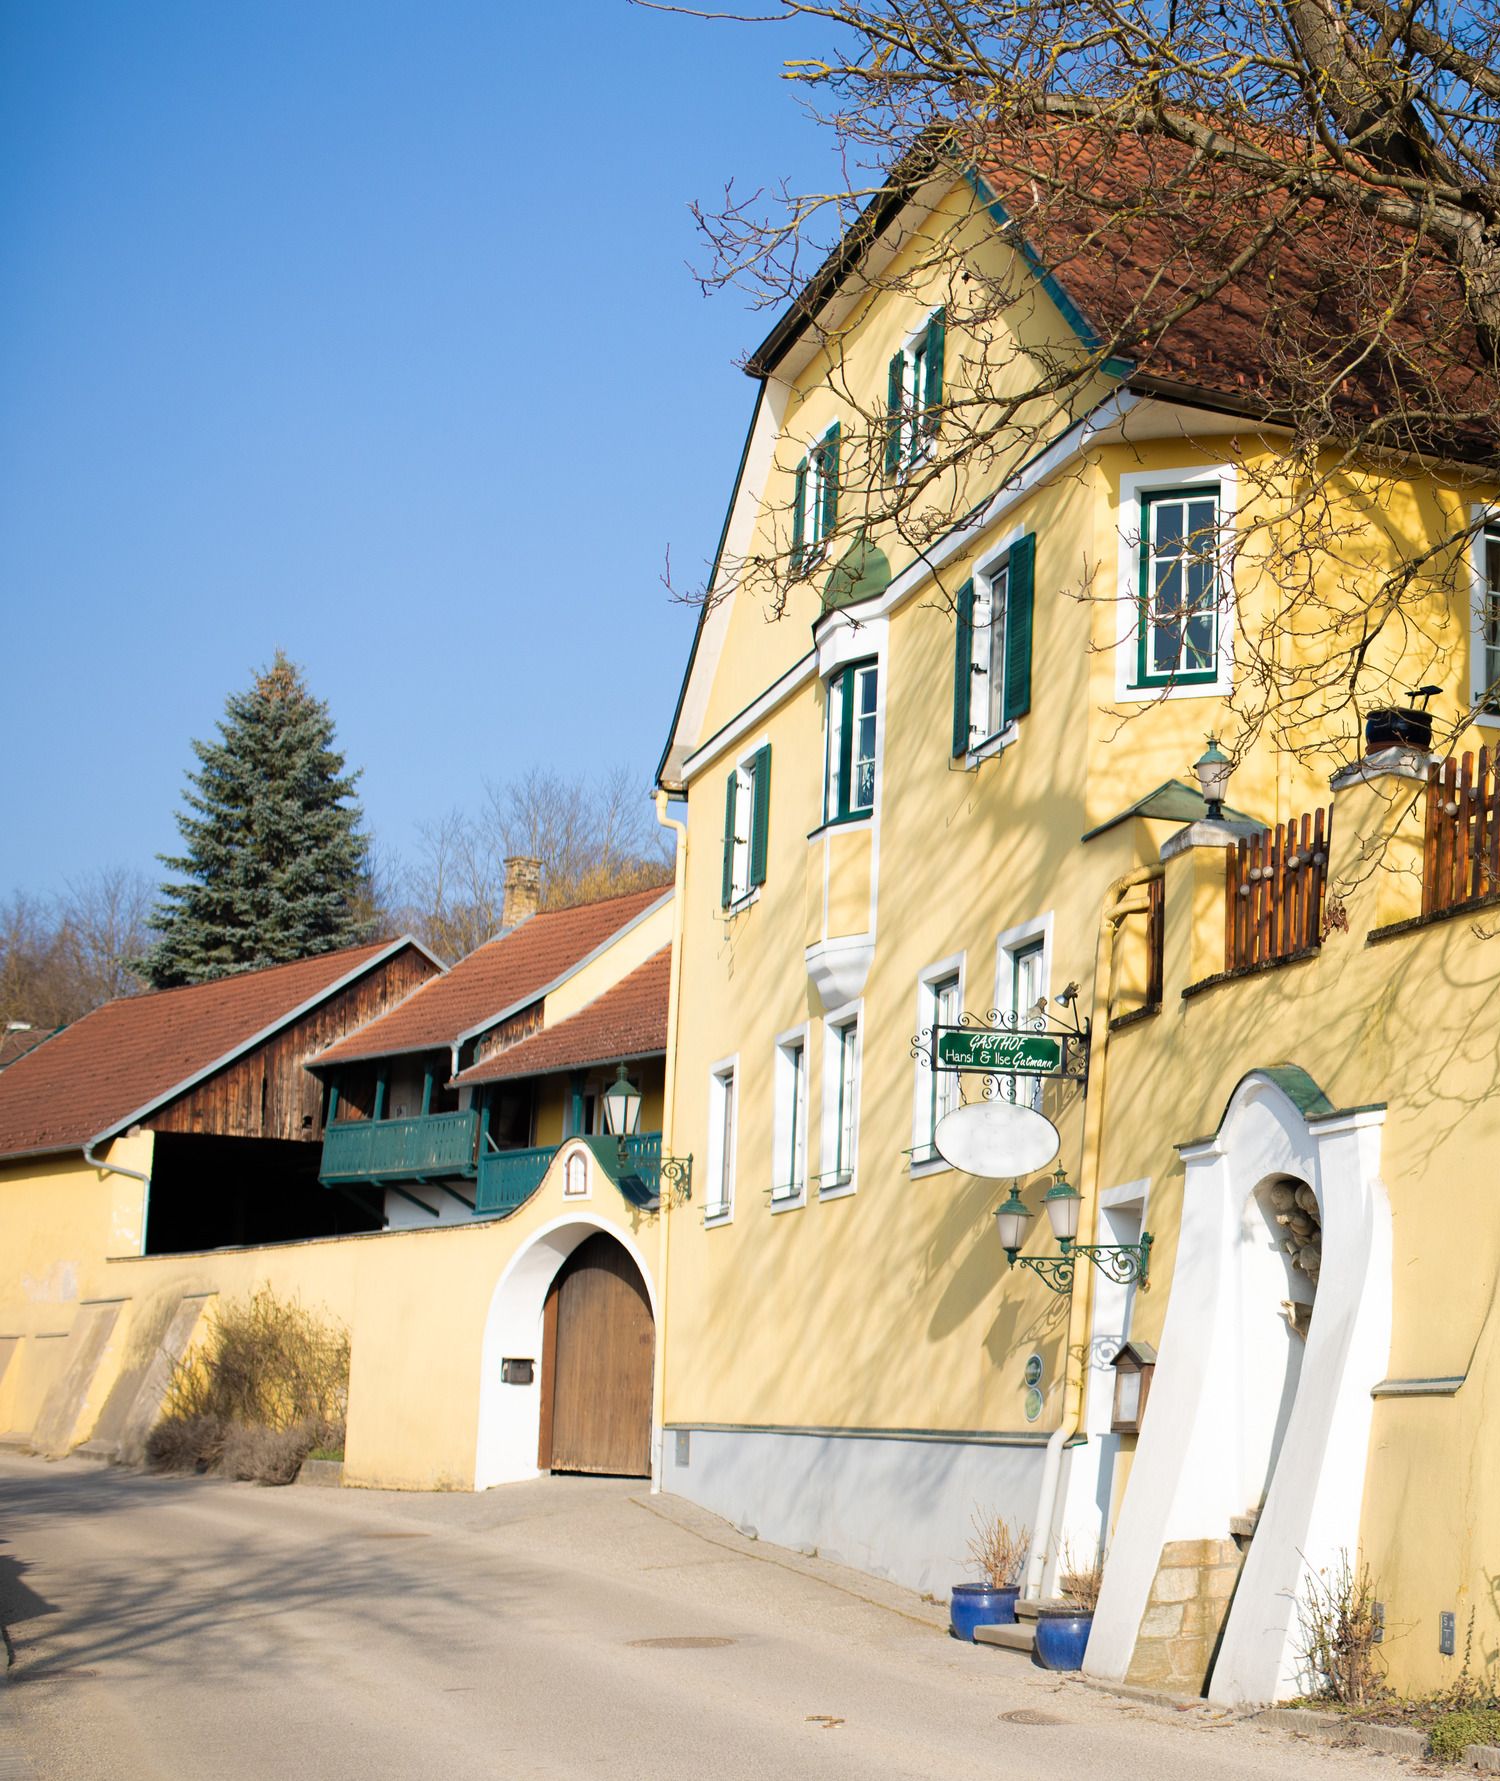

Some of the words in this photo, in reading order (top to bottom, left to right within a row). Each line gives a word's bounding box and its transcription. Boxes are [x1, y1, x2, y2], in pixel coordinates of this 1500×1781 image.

[969, 1034, 1028, 1051] GASTHOF
[945, 1049, 974, 1063] Hansi
[980, 1051, 991, 1064] &
[995, 1052, 1011, 1065] Ilse
[1012, 1052, 1053, 1069] Gutmann
